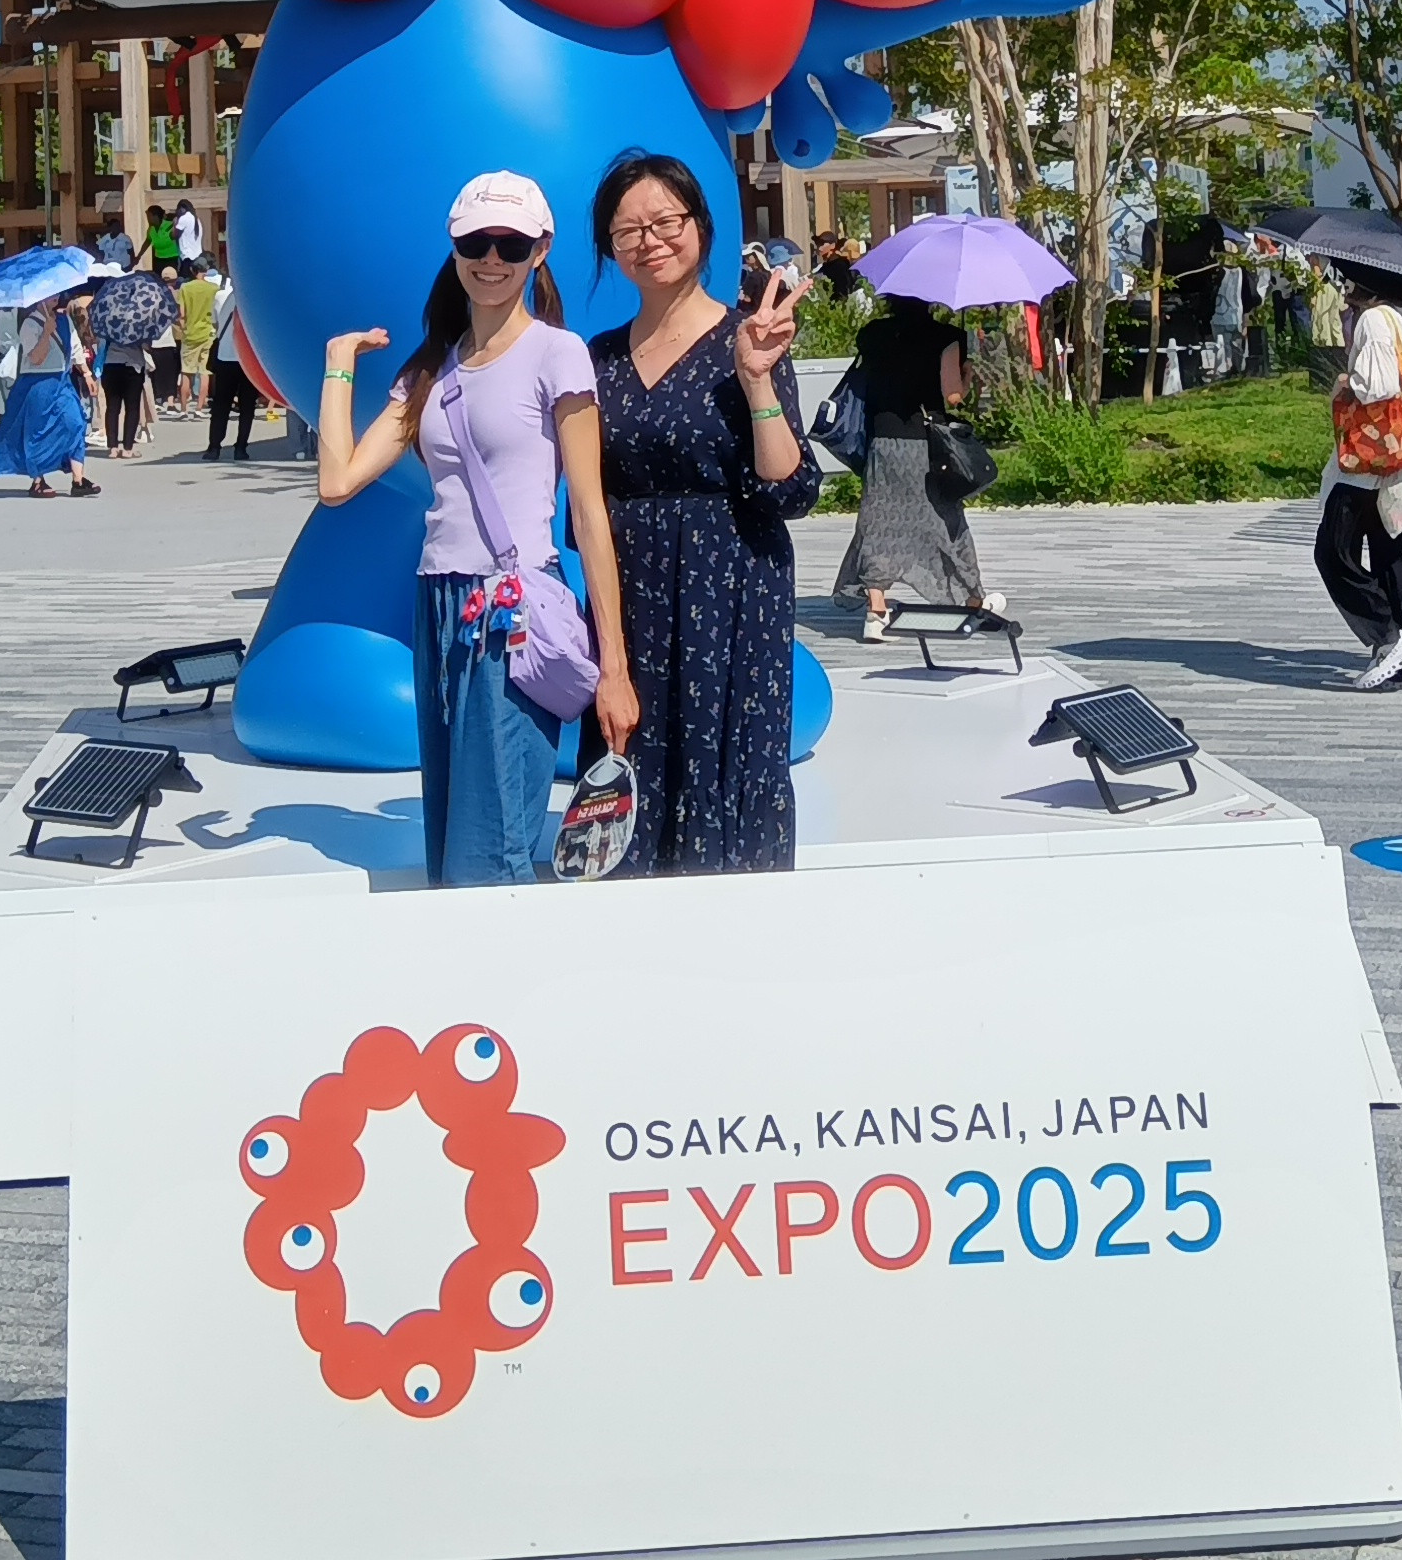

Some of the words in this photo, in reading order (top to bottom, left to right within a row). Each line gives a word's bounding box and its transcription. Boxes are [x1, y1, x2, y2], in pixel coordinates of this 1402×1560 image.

[605, 1114, 802, 1162] OSAKA,
[816, 1101, 1026, 1149] KANSAI,
[1042, 1091, 1209, 1138] JAPAN
[503, 1363, 523, 1375] TM
